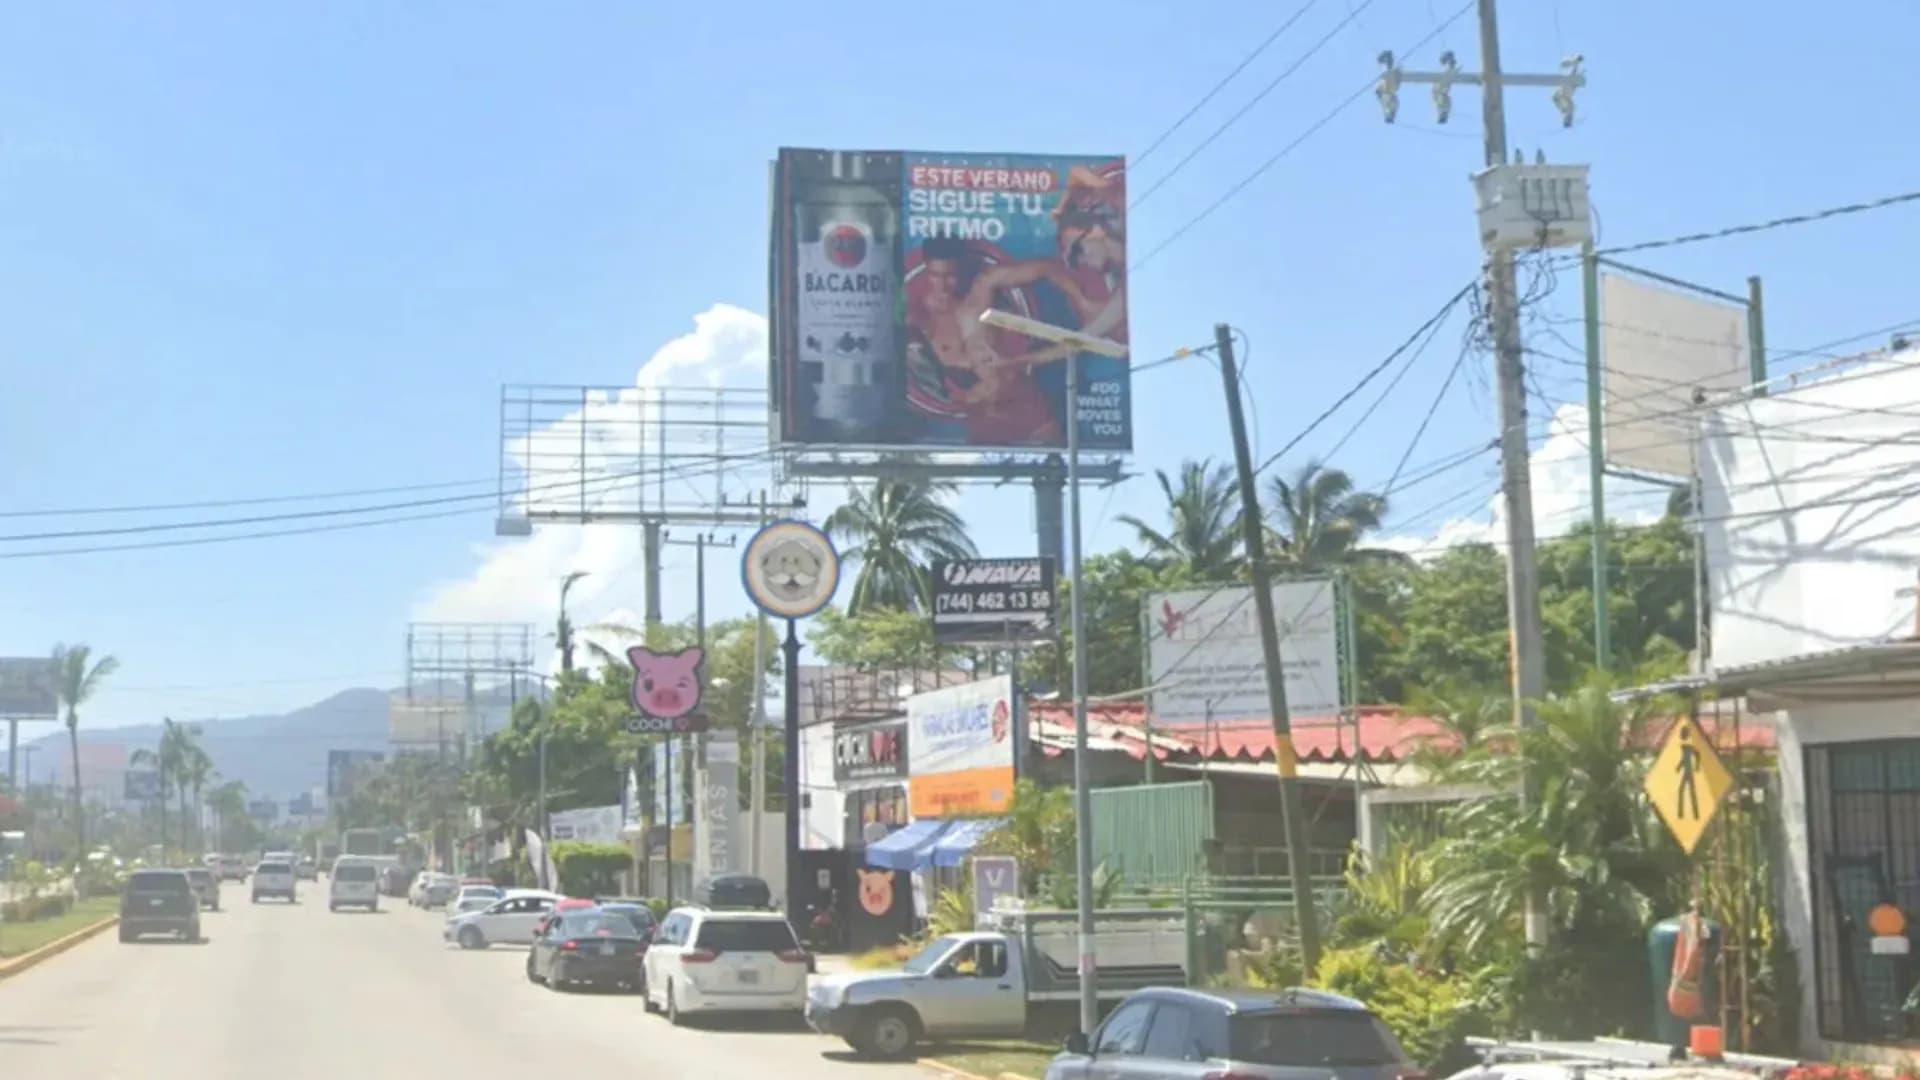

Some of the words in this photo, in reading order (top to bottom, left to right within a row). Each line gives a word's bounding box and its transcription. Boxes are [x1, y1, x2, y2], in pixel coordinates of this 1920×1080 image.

[912, 166, 966, 187] ESTE
[967, 168, 1051, 190] VERANO
[909, 188, 995, 214] SIGUE
[999, 191, 1043, 216] TU
[909, 215, 1004, 241] RITMO
[1092, 423, 1122, 436] YOU
[936, 592, 973, 613] (744)
[976, 591, 1005, 609] 462
[1008, 591, 1029, 609] 13
